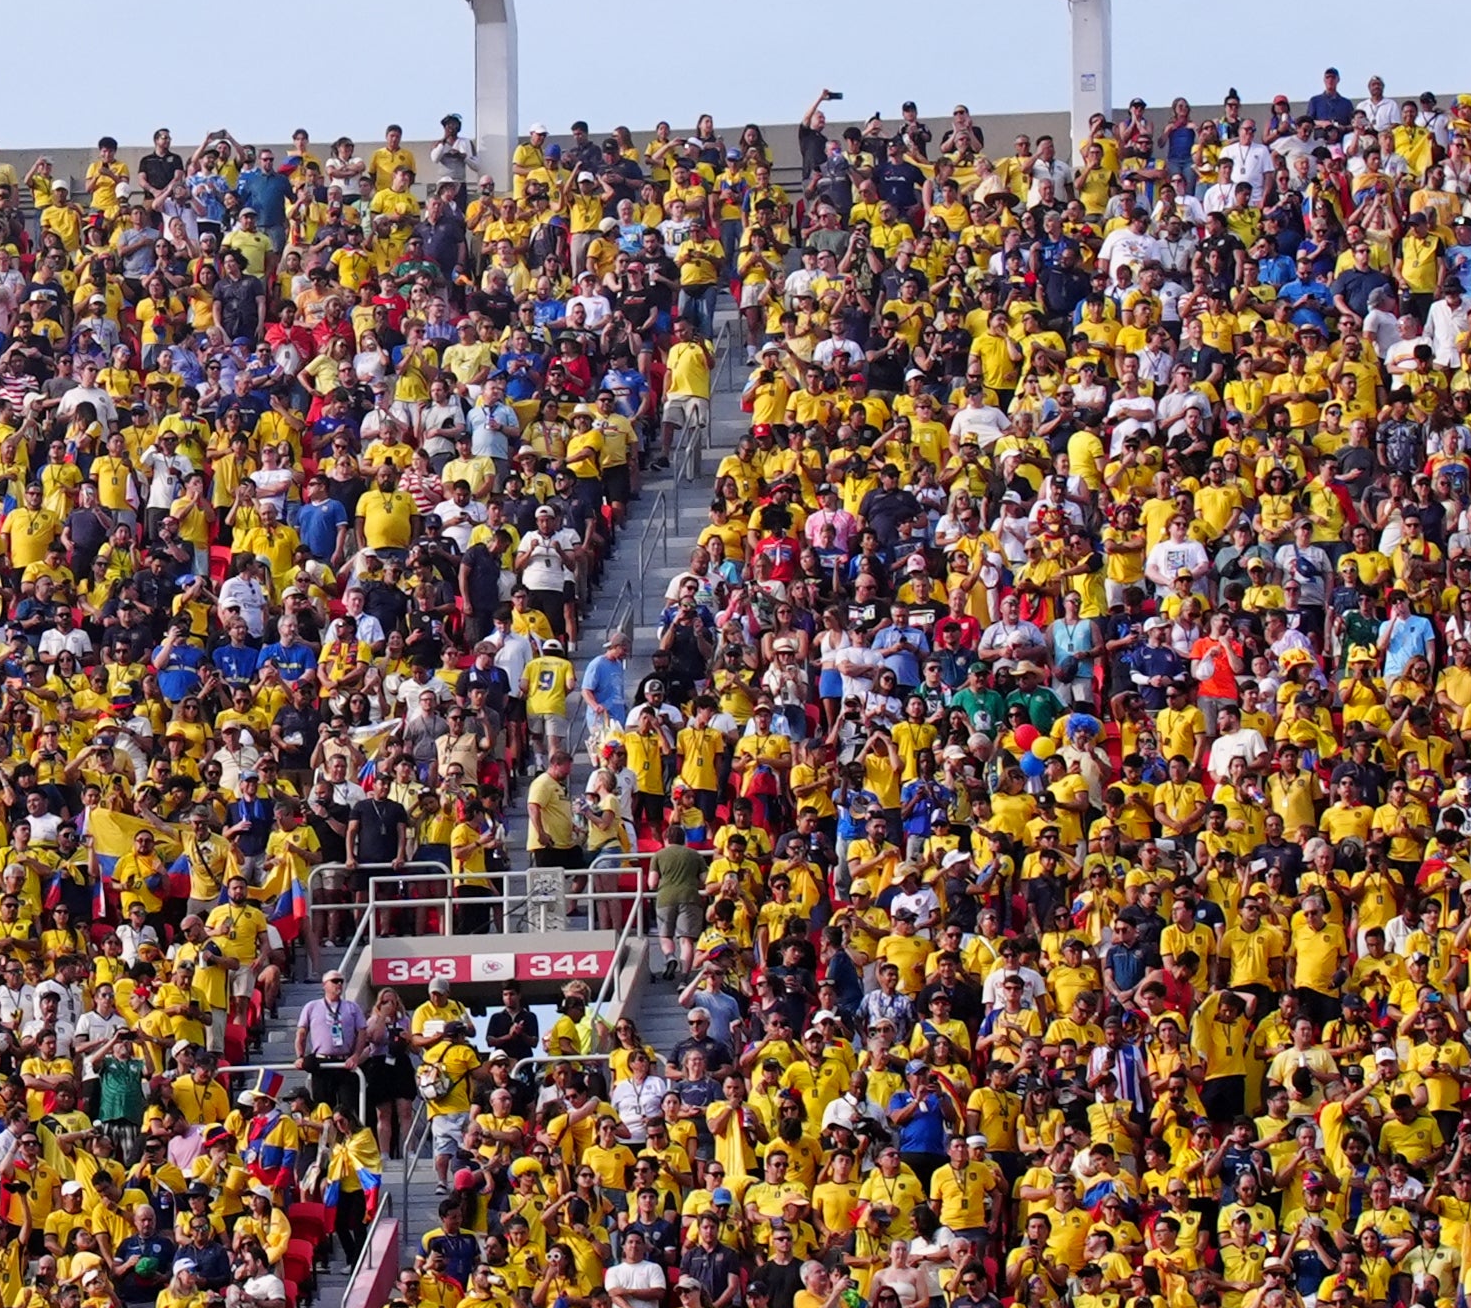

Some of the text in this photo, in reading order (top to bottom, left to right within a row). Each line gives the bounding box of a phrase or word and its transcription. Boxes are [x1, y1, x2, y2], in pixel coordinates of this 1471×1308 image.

[538, 670, 554, 691] 9
[387, 959, 457, 982] 343
[530, 954, 600, 976] 344
